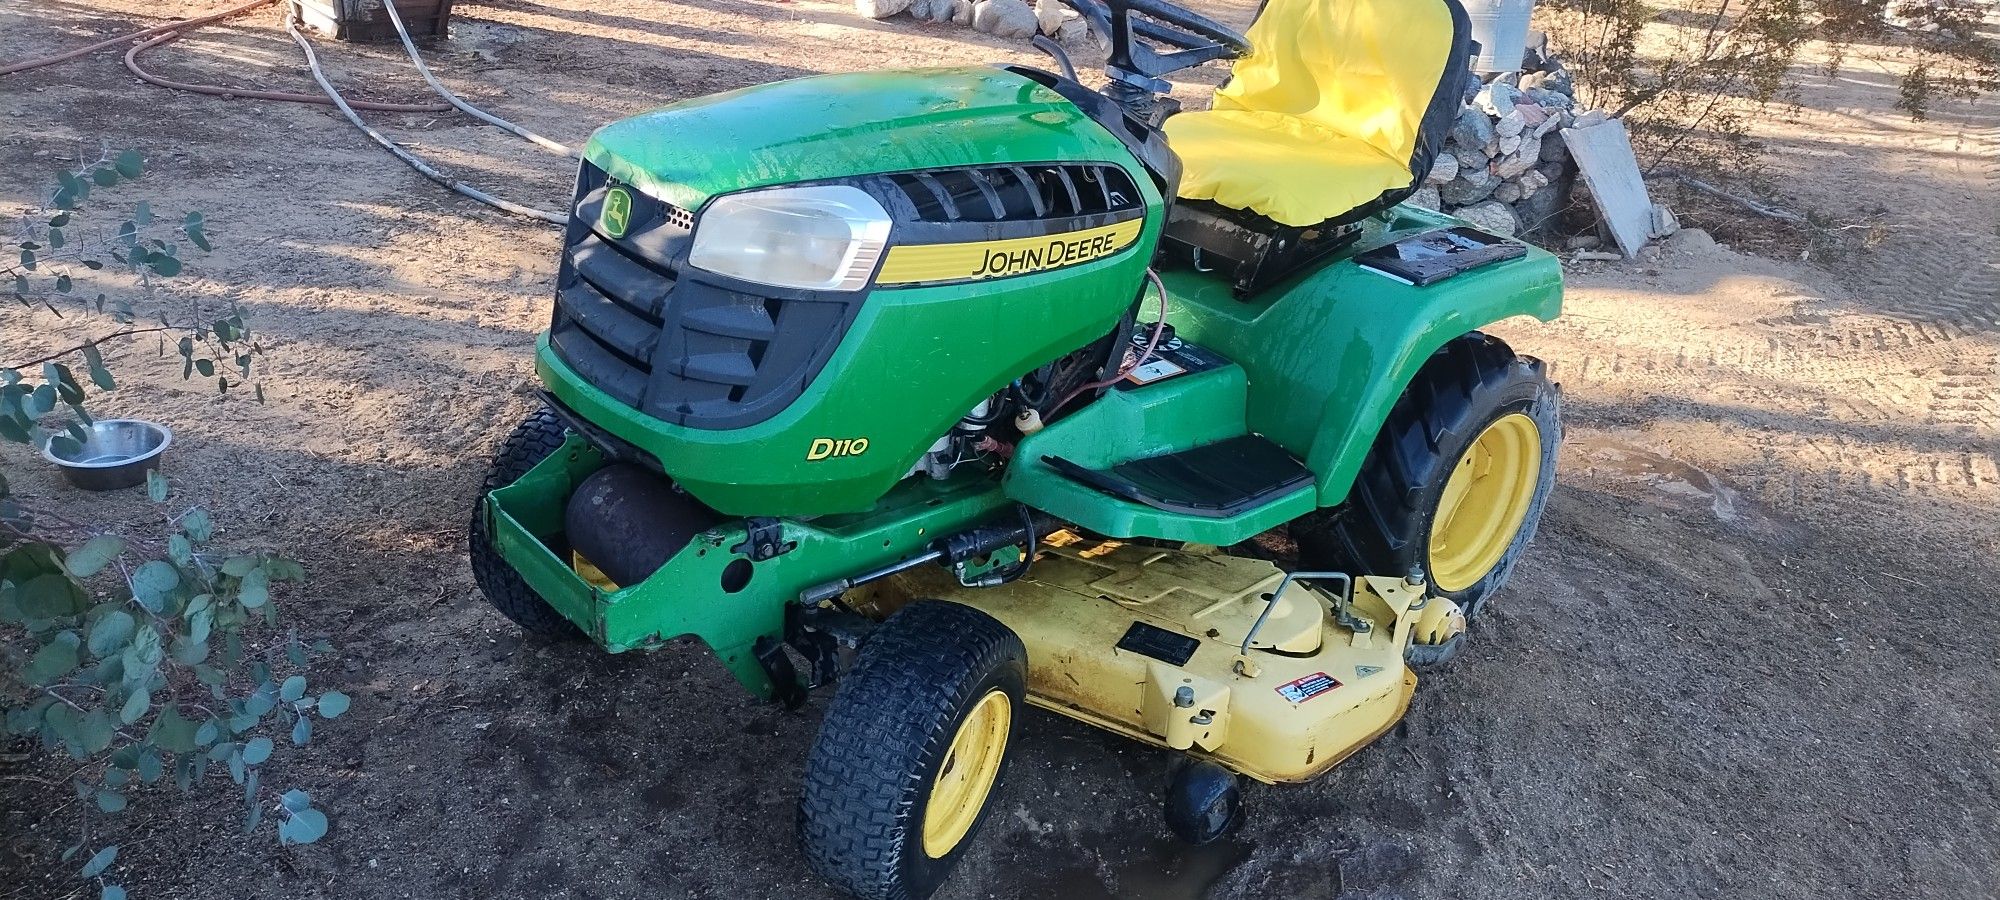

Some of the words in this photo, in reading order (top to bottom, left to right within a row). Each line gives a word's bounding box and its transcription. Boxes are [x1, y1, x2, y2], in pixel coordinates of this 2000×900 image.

[972, 248, 1043, 275] JOHN
[1047, 232, 1116, 265] DEERE
[806, 438, 869, 460] D110
